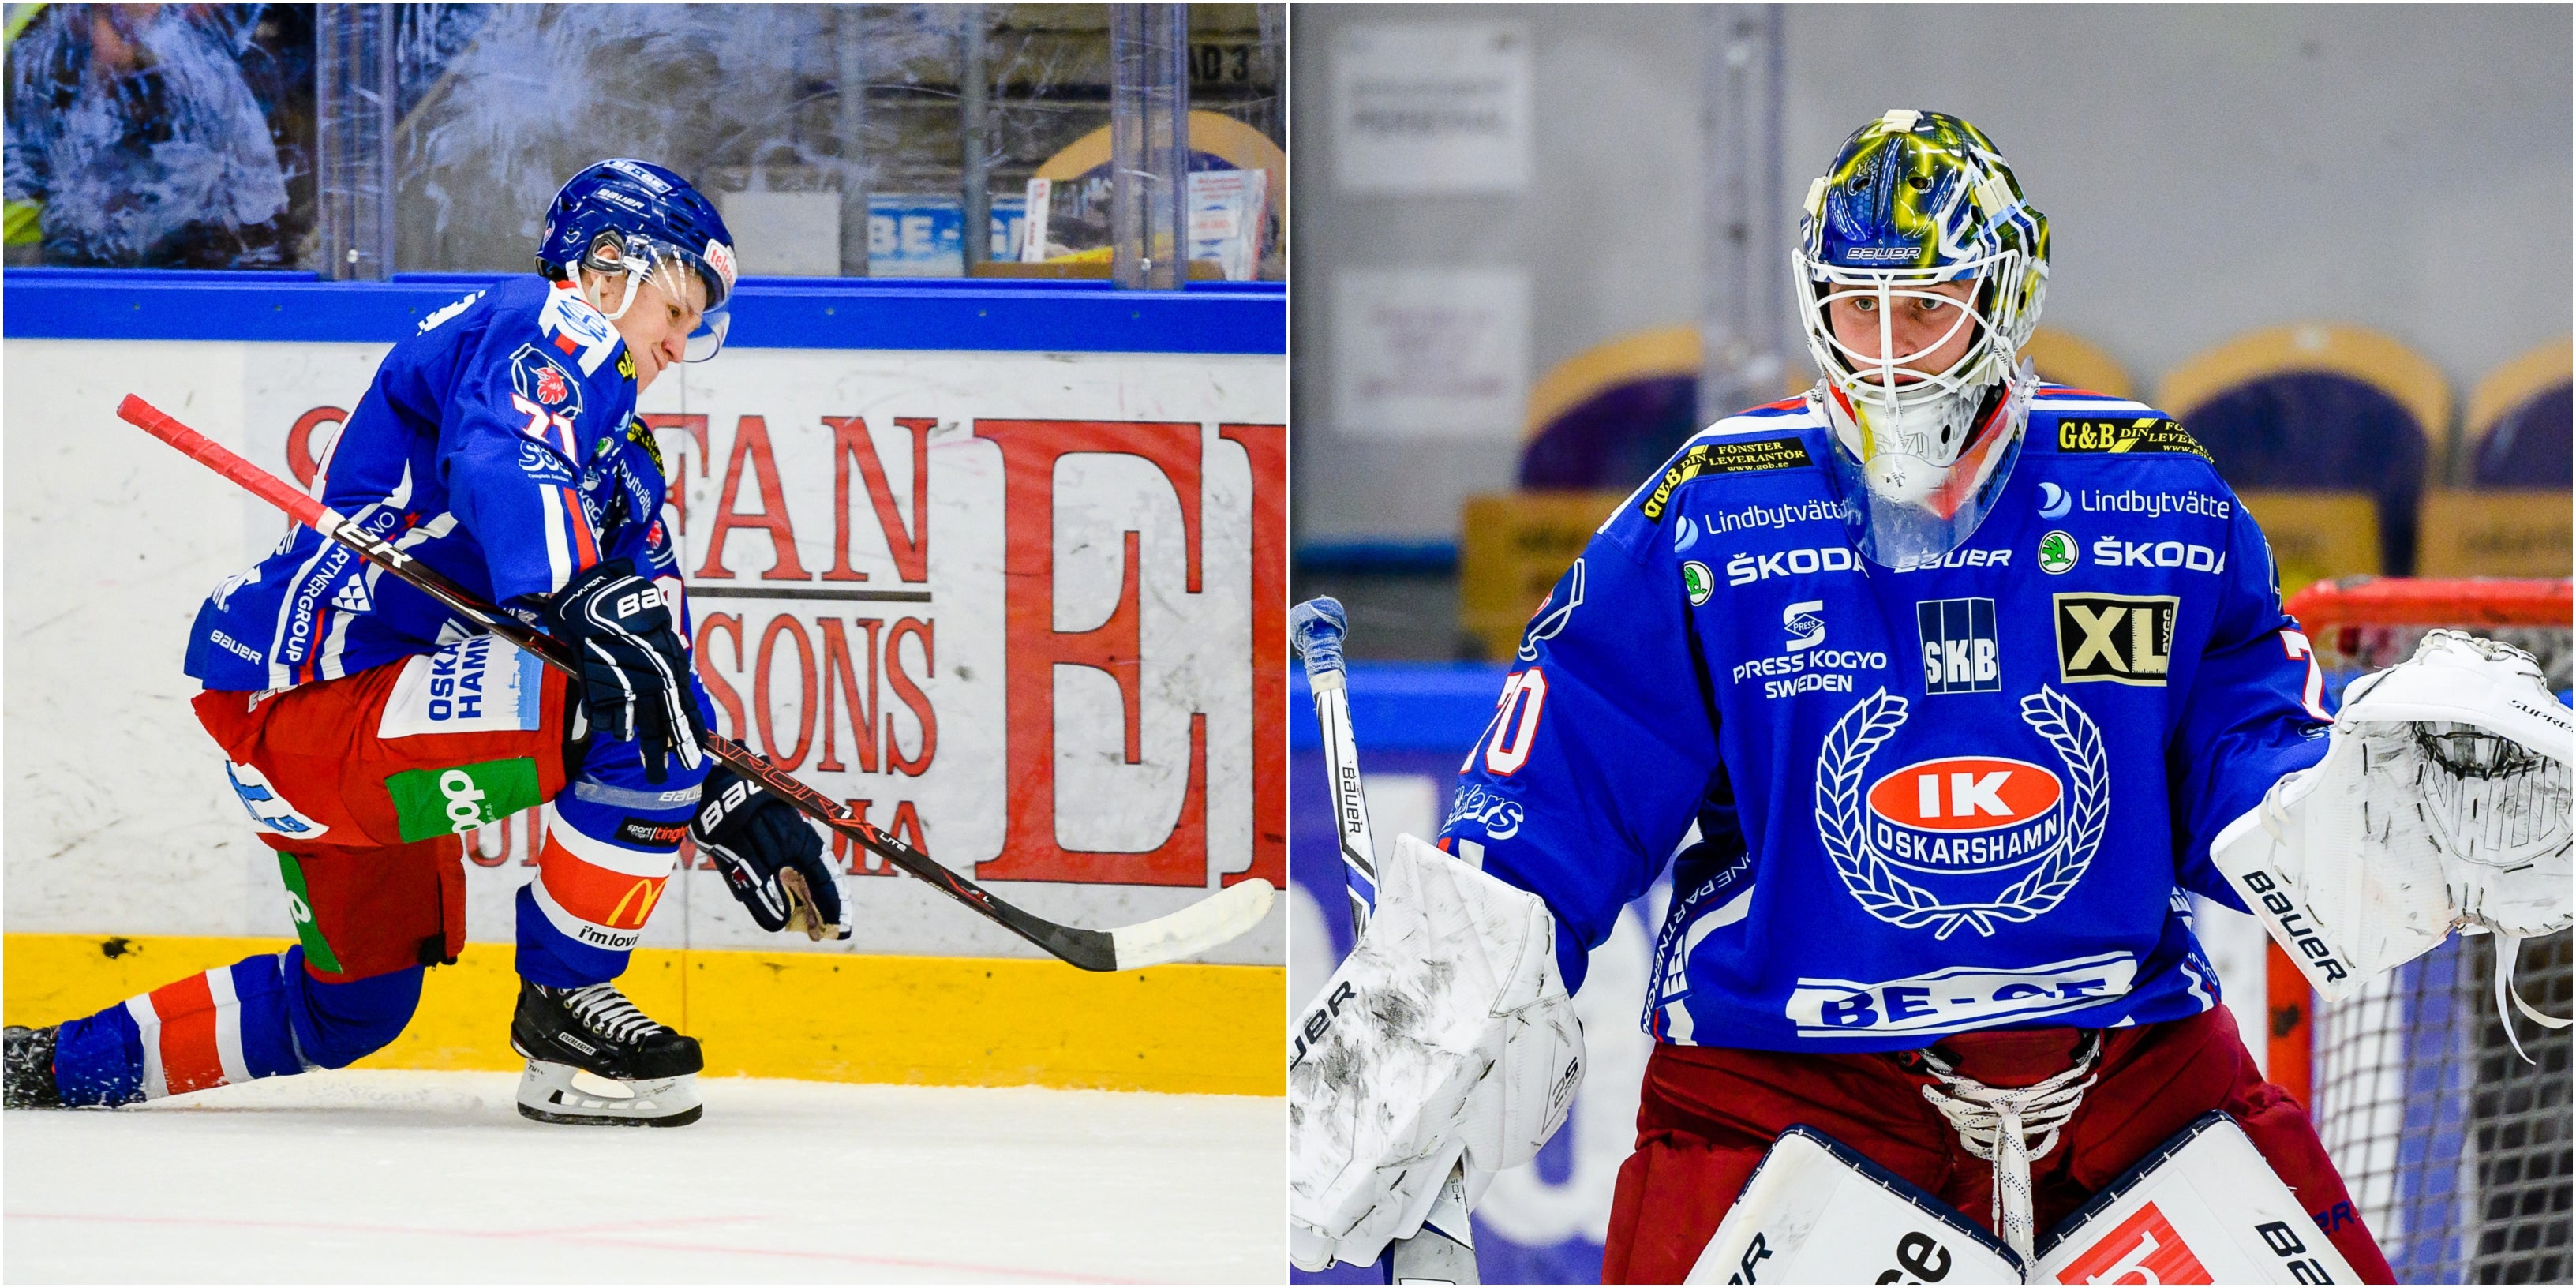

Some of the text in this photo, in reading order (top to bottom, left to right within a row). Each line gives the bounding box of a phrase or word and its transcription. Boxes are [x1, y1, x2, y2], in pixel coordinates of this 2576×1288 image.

[597, 189, 645, 208] BAUER
[1846, 247, 1921, 260] BAUER
[1717, 440, 1783, 455] FÖNSTER
[2059, 421, 2115, 450] G&B
[2120, 428, 2149, 438] DIN
[1681, 453, 1707, 470] DIN
[1709, 448, 1805, 466] LEVERANTÖR
[1727, 461, 1789, 474] www.gob.se
[1726, 546, 1870, 587] ŠKODA
[1894, 549, 2012, 574] BAUER
[1792, 620, 1816, 631] PRESS
[210, 629, 263, 665] BAUER
[2065, 605, 2169, 674] XL
[1733, 650, 1887, 684] PRESS KOGYO
[1924, 638, 1998, 684] SKB
[1765, 674, 1853, 699] SWEDEN
[1458, 666, 1548, 777] 70
[2508, 699, 2573, 733] SUPRE
[1342, 766, 1363, 833] BAUER
[1918, 770, 2016, 818] IK
[879, 833, 907, 852] LITE
[1877, 814, 2058, 865] OSKARSHAMN
[578, 925, 608, 945] i'm
[2241, 871, 2348, 984] BAUER
[559, 1032, 595, 1055] BAUER
